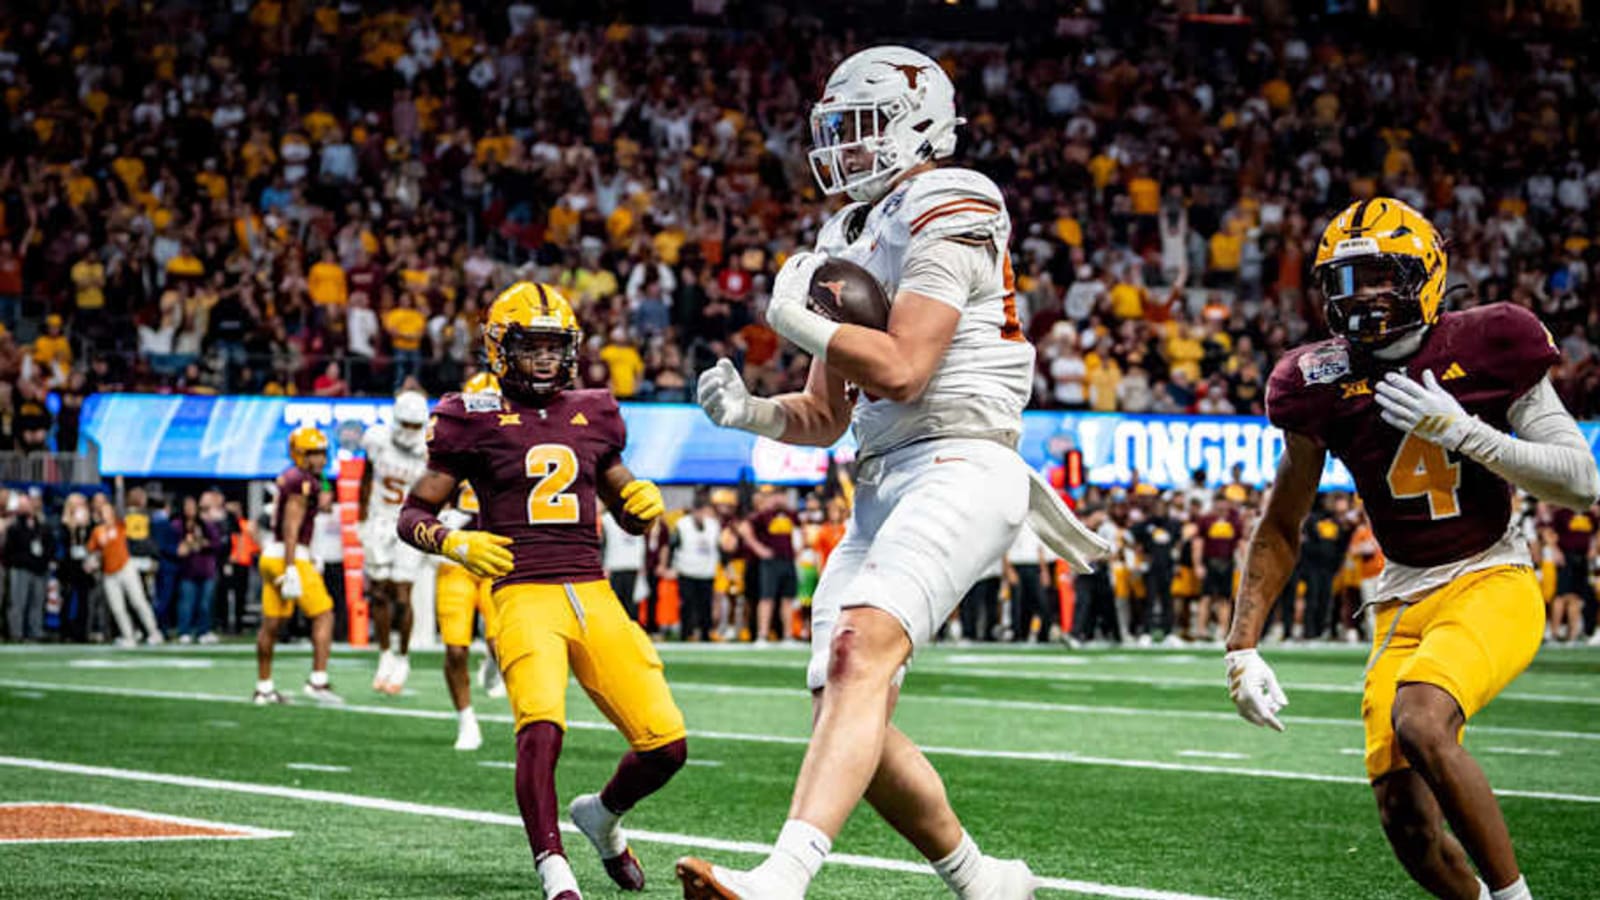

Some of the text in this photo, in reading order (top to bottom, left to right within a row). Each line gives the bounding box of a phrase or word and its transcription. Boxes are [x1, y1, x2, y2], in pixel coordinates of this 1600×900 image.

[525, 443, 580, 524] 2
[1078, 420, 1353, 486] LONGHO
[1386, 432, 1461, 521] 4
